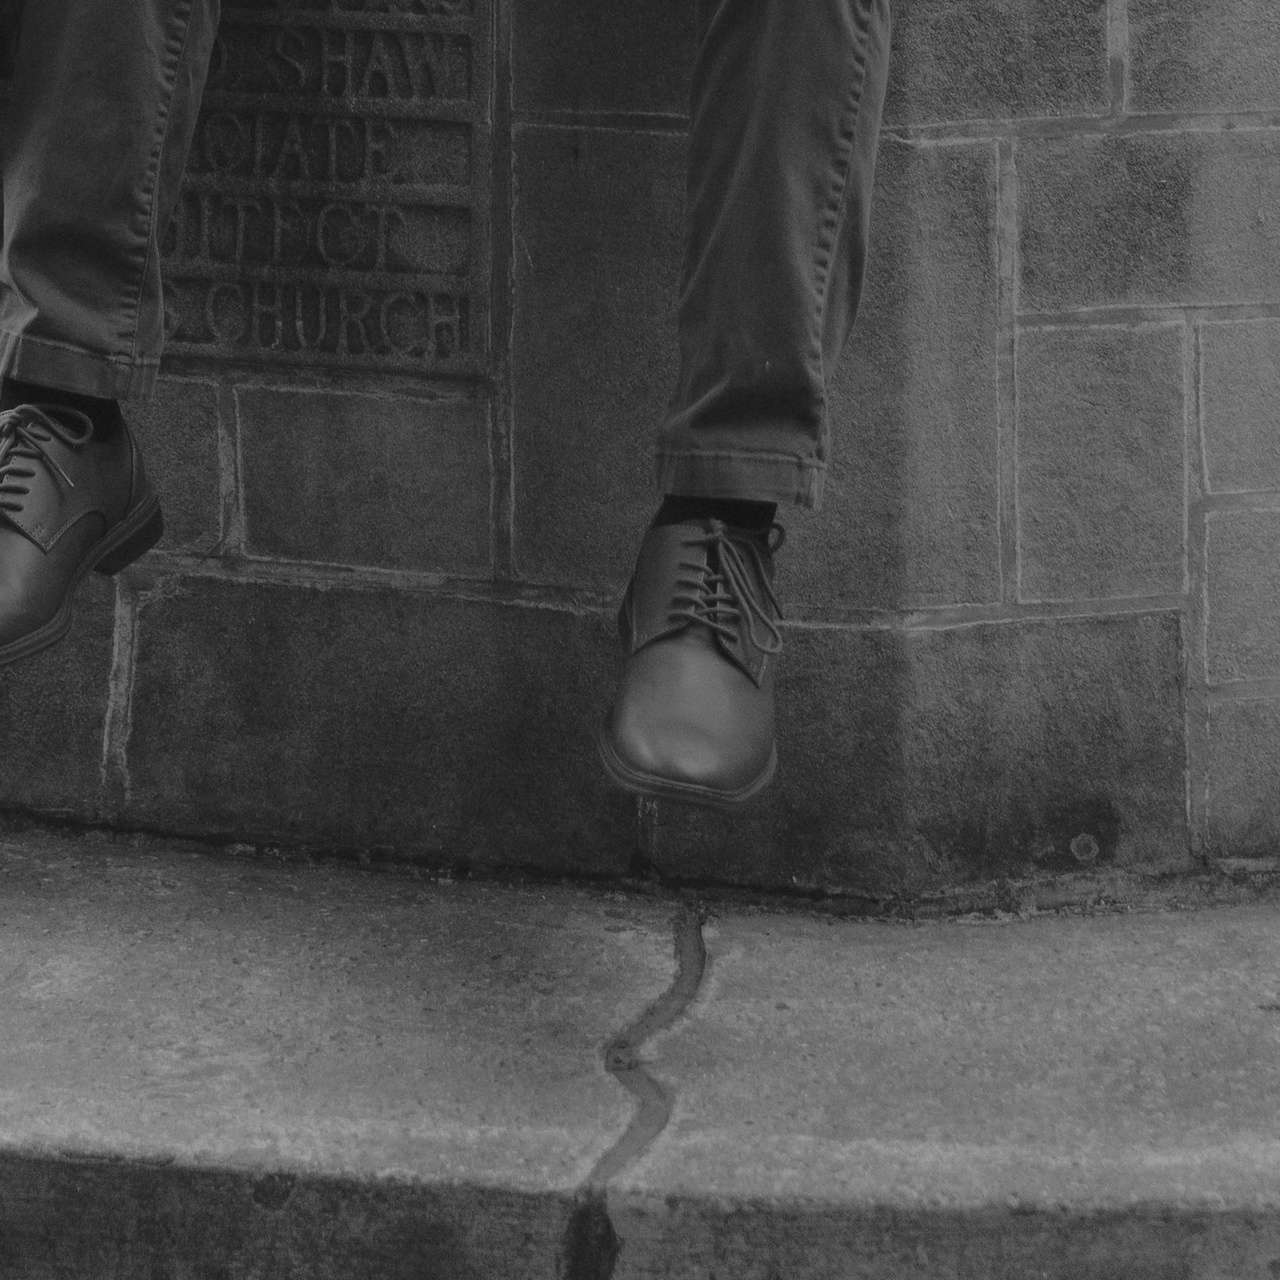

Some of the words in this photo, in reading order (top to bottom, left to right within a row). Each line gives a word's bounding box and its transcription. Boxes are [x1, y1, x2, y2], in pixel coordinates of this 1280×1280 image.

[267, 27, 447, 98] SHAW
[204, 112, 402, 181] CIATE
[205, 281, 462, 357] CHURCH
